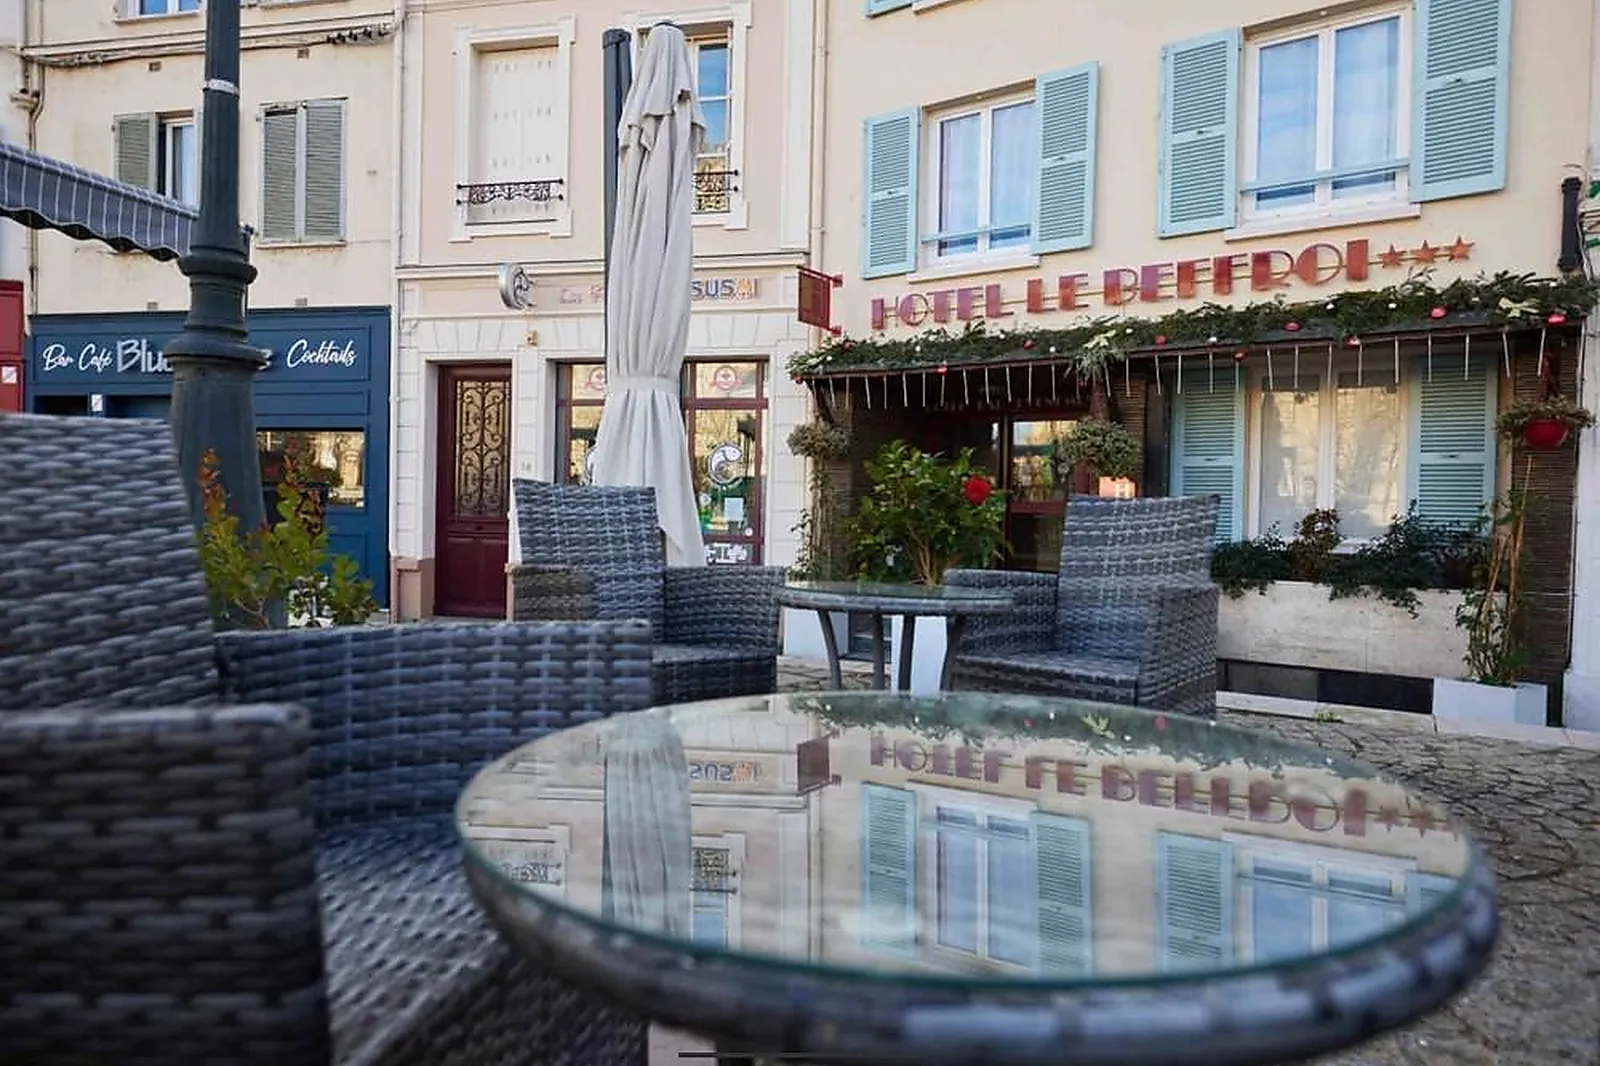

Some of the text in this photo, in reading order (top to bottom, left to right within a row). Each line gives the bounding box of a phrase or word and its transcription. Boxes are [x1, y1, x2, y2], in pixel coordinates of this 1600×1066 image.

[871, 239, 1369, 330] HOTEL LE BEFFROI
[42, 343, 74, 371] Bar
[78, 343, 113, 373] Café
[287, 339, 356, 368] Cocktails
